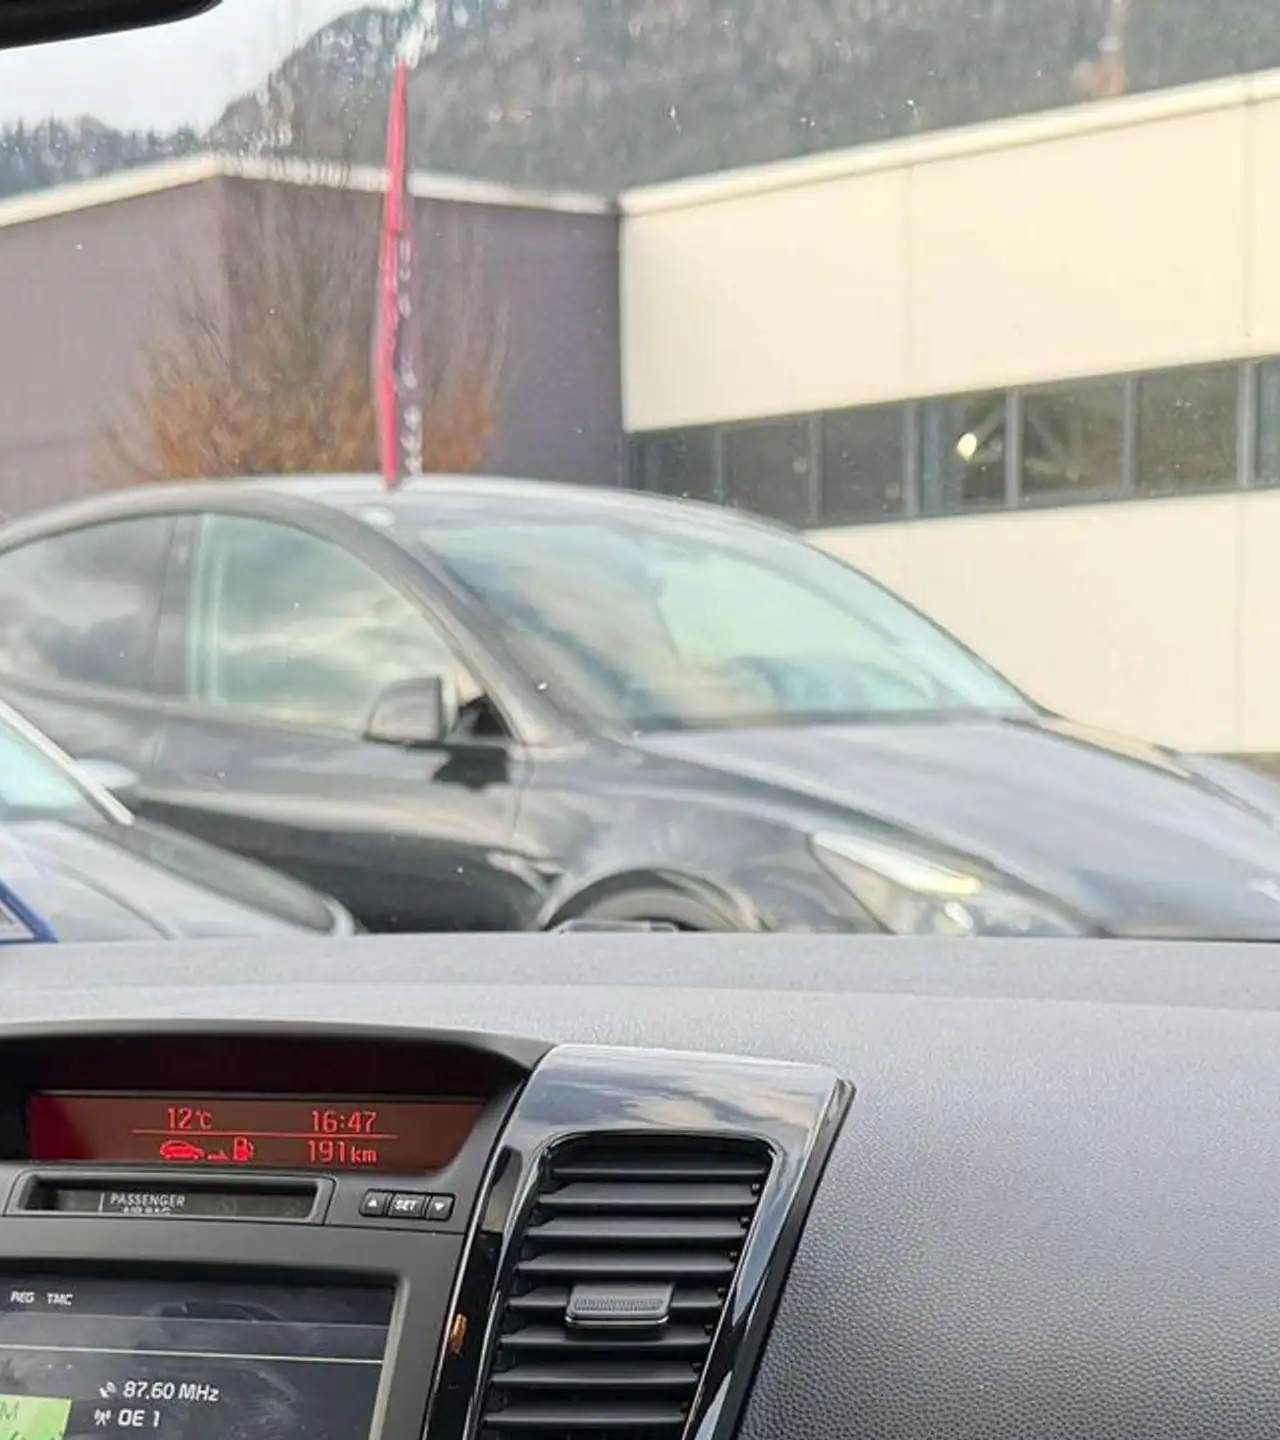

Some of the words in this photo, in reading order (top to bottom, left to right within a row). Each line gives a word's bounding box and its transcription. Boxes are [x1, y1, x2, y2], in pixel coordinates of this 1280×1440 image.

[311, 1110, 376, 1133] 16:47
[308, 1140, 346, 1164] 191
[350, 1146, 377, 1164] km
[110, 1192, 186, 1207] PASSENGER
[393, 1200, 417, 1211] SET
[10, 1291, 34, 1304] REG
[46, 1293, 73, 1305] TMC
[122, 1380, 175, 1400] 87.60
[178, 1383, 219, 1402] MHz
[151, 1410, 161, 1428] 1
